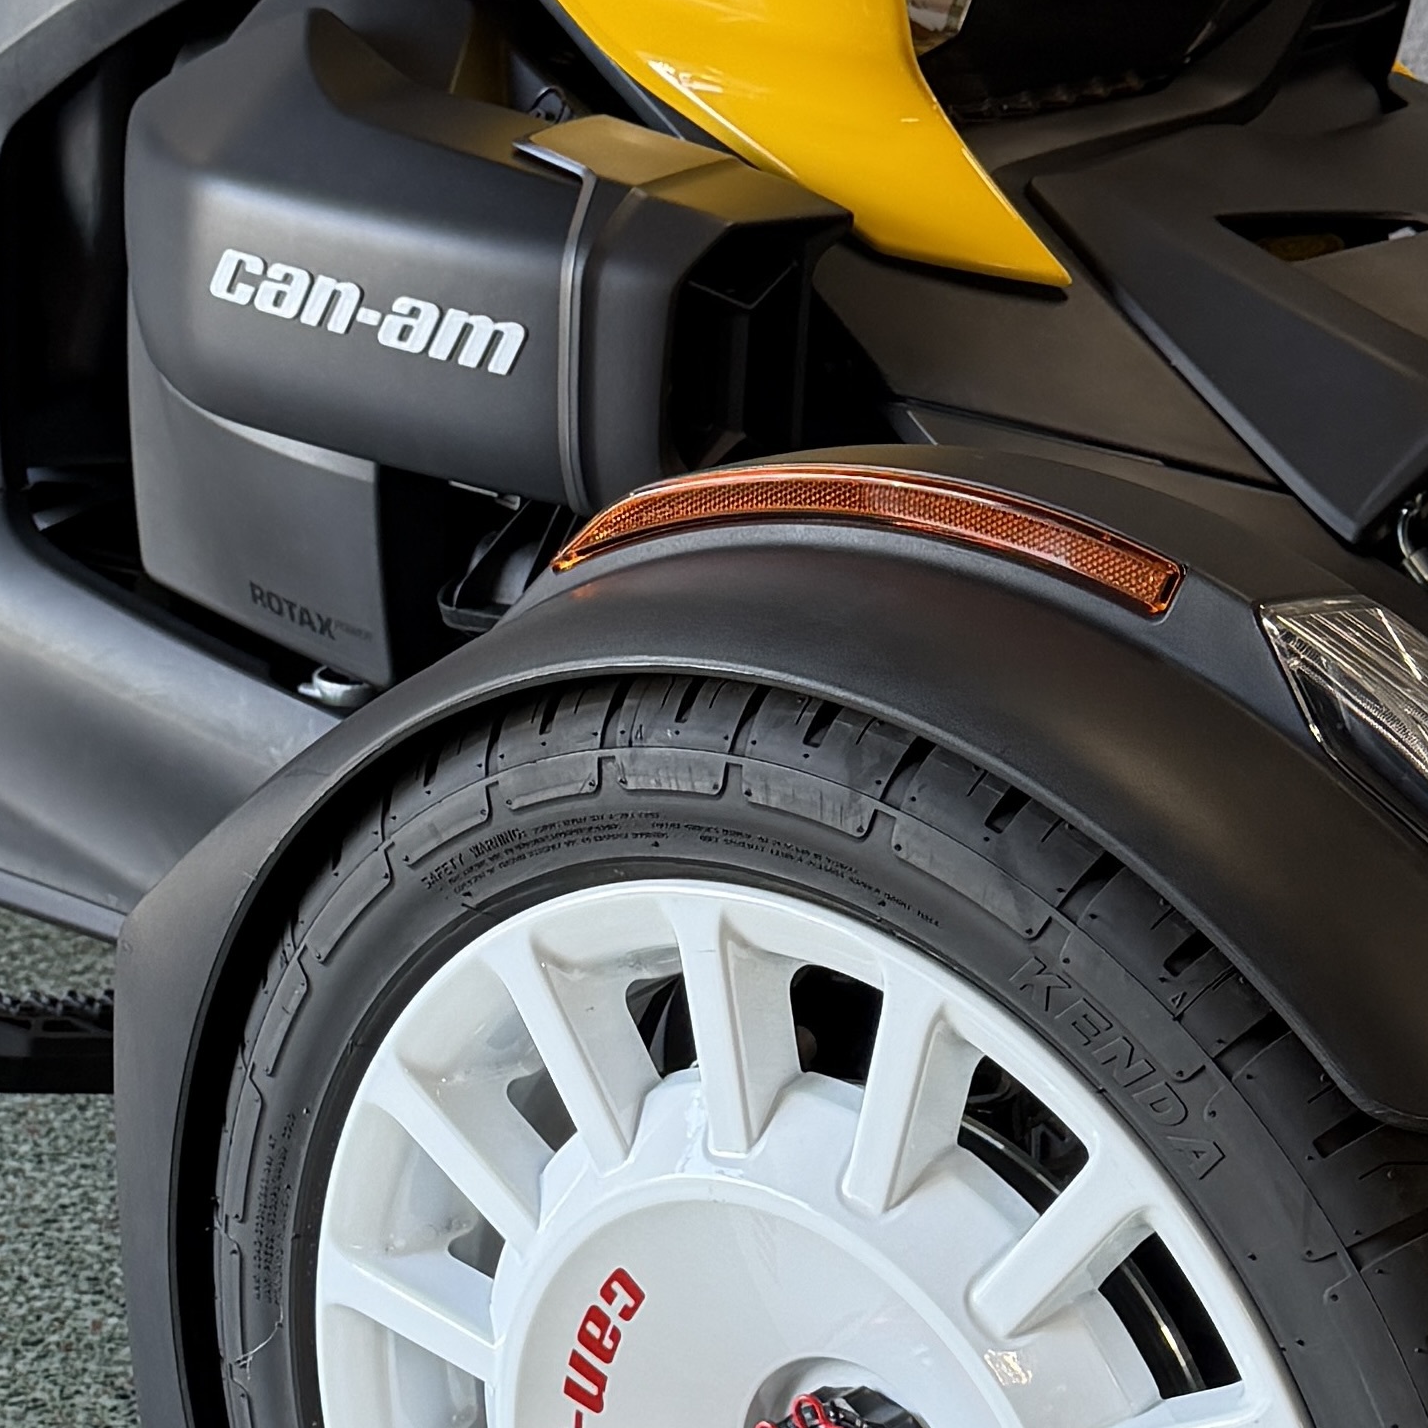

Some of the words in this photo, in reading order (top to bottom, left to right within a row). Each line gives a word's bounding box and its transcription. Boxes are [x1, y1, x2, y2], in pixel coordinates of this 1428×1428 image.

[210, 249, 526, 375] can-am
[249, 579, 336, 641] ROTAX
[1008, 956, 1227, 1180] KENDA
